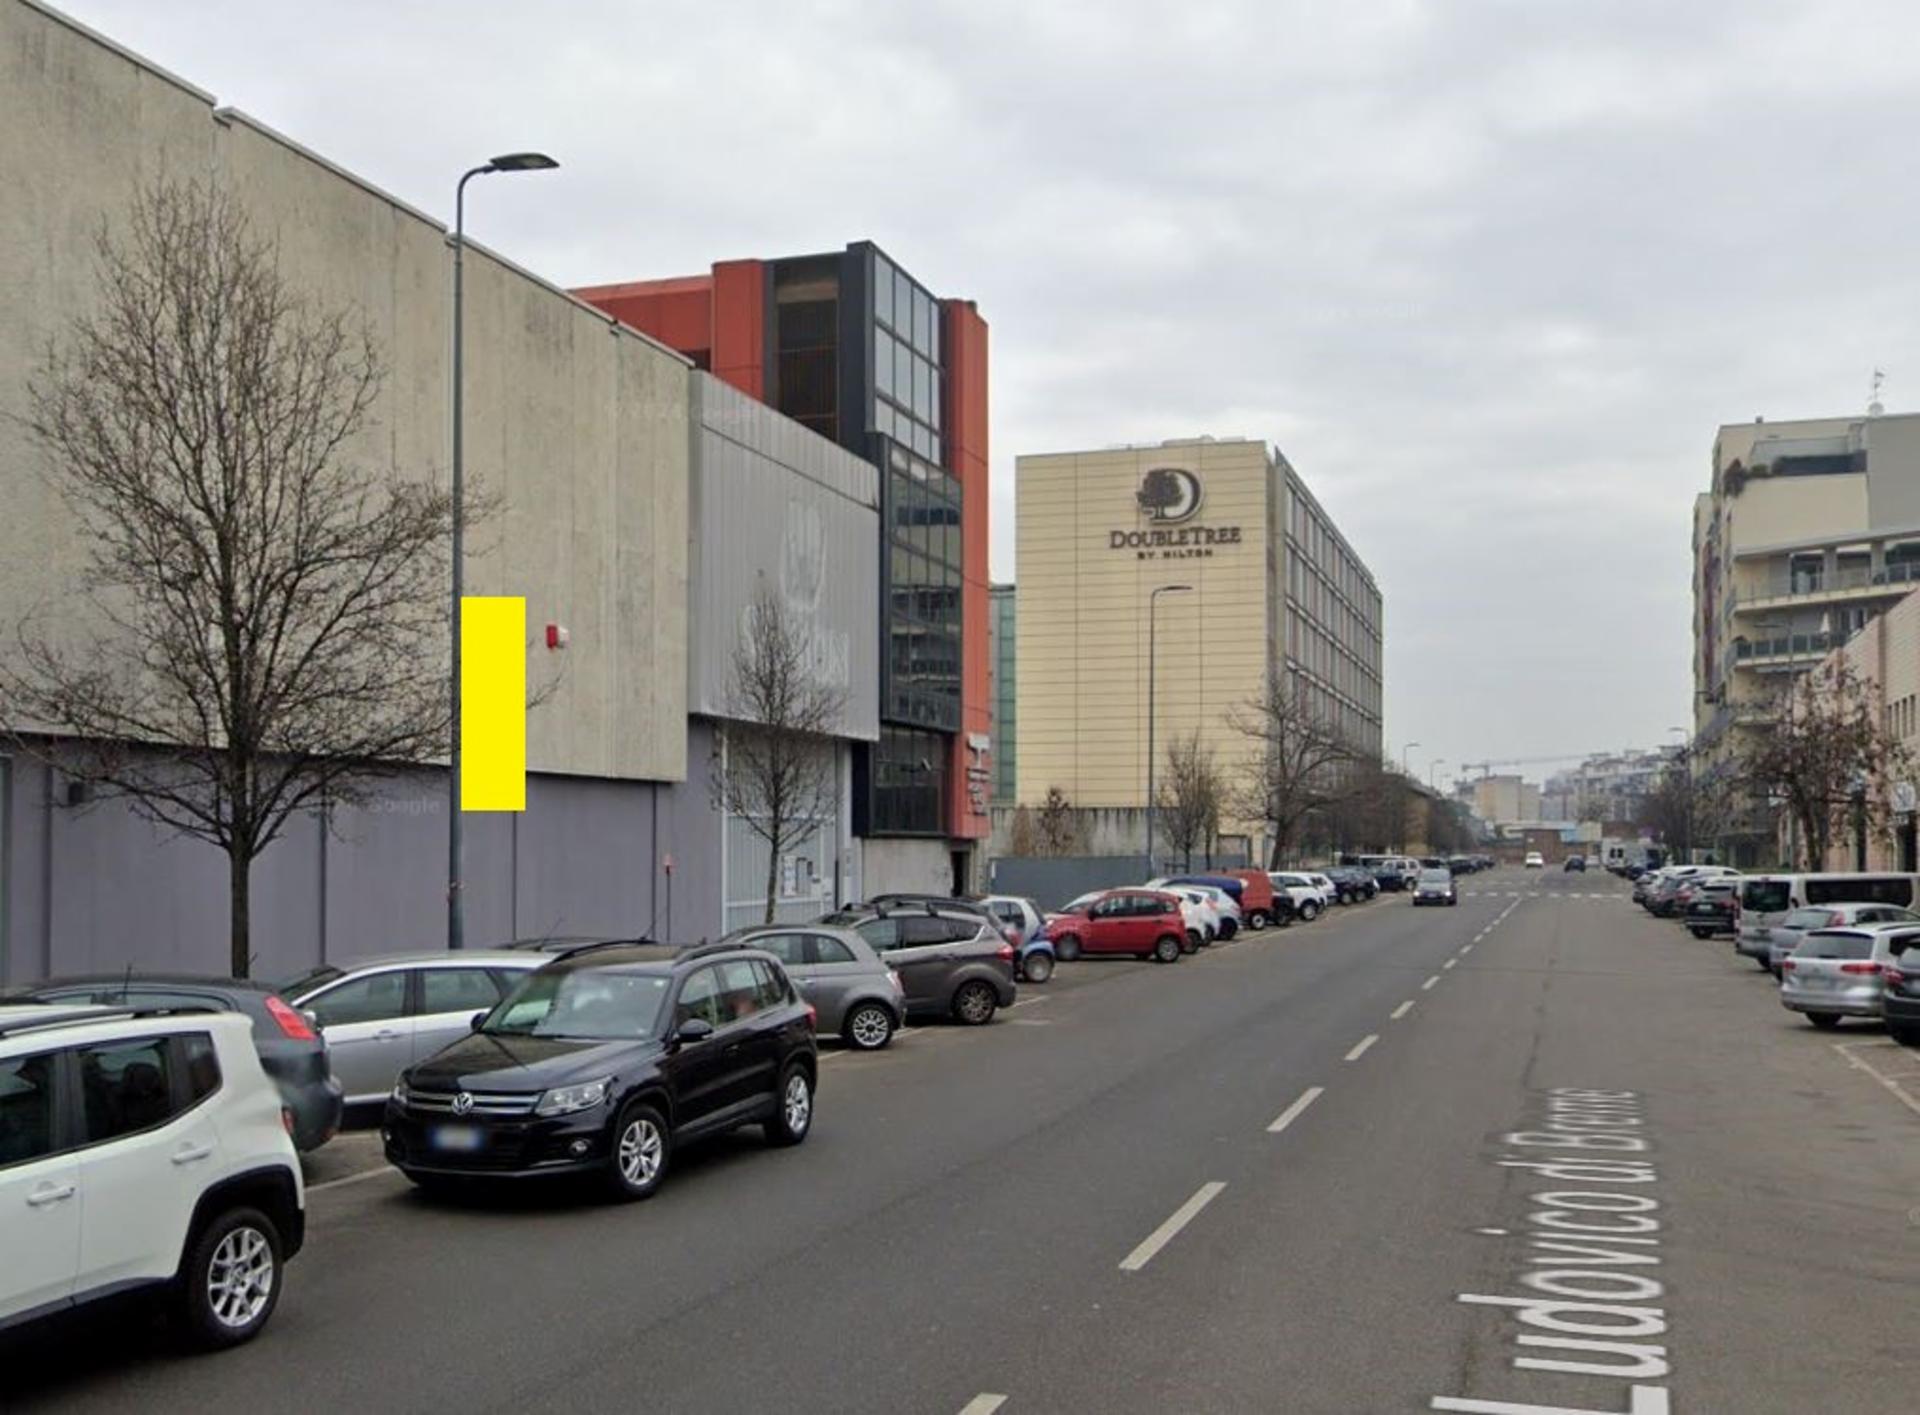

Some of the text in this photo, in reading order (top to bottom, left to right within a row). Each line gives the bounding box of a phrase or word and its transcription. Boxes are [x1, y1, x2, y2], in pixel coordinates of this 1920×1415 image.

[1137, 548, 1213, 560] BY HILTON
[1430, 1087, 1669, 1415] Ludovico di Breme
